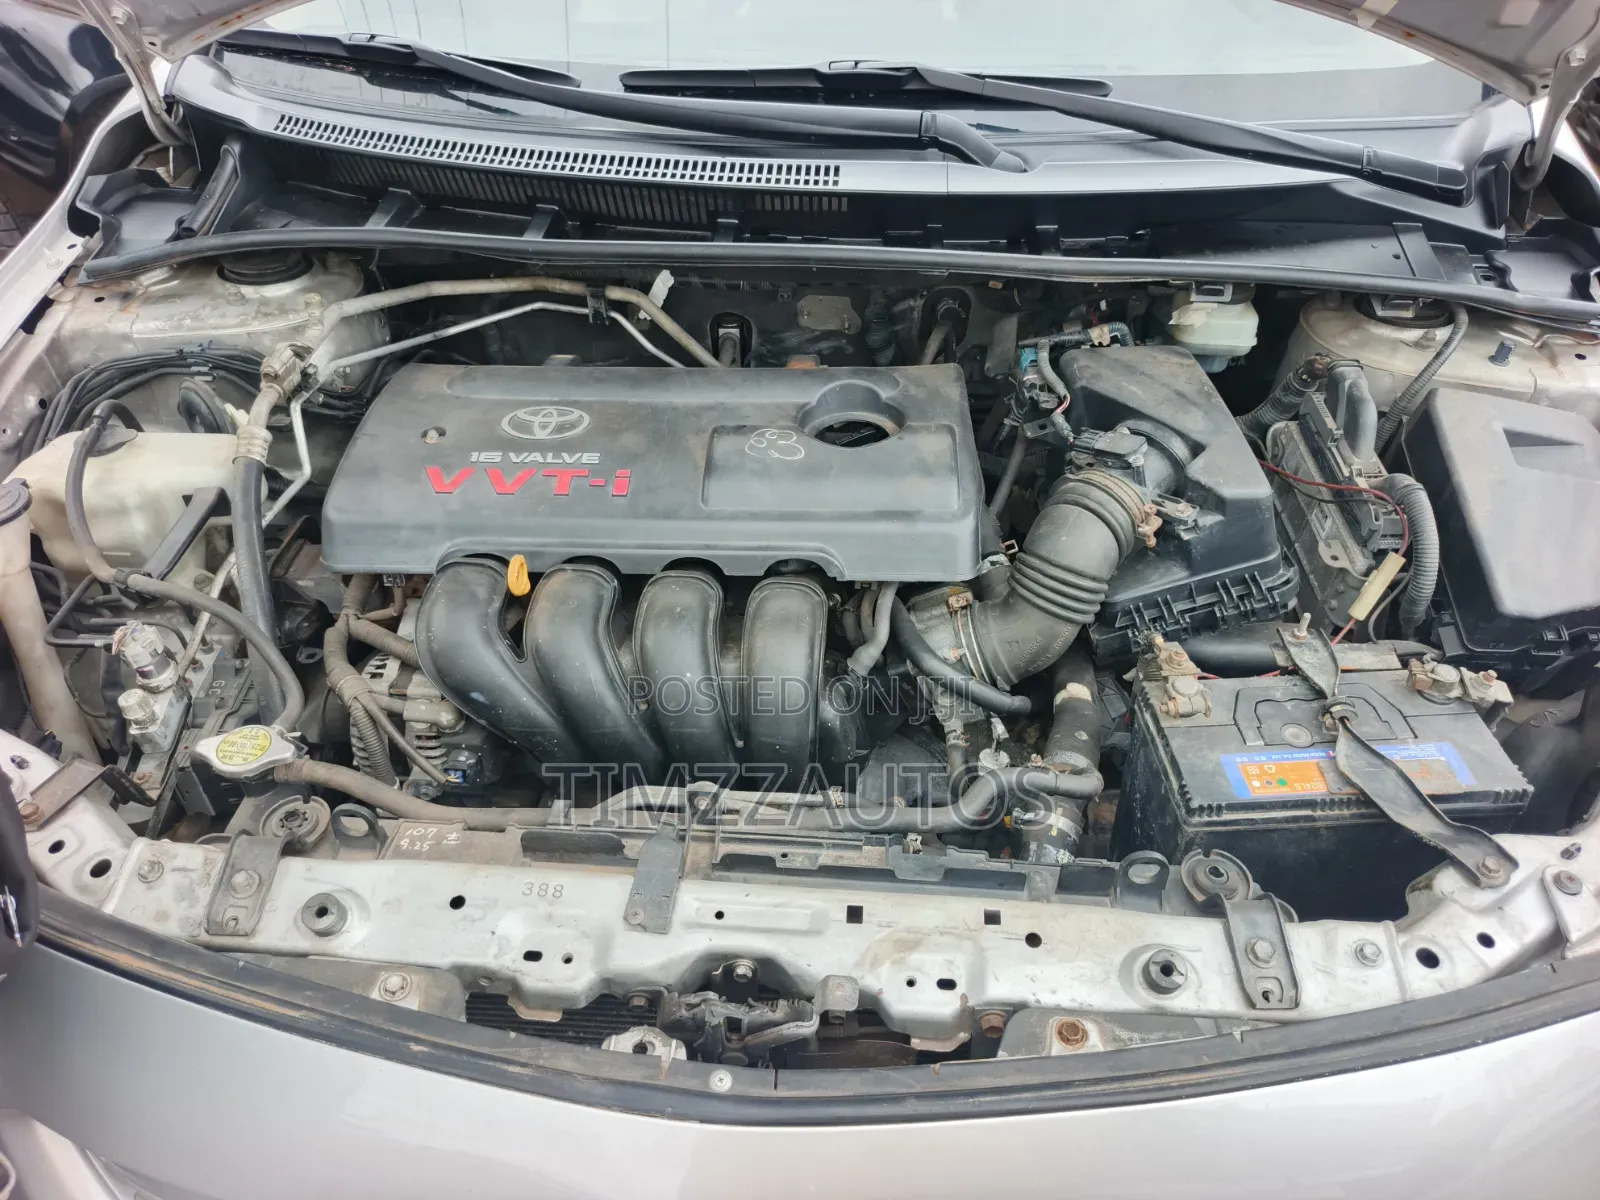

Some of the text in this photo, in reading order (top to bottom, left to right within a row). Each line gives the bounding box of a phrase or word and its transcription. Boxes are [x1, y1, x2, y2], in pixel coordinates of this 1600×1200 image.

[470, 451, 601, 464] 16 VALVE
[425, 466, 632, 496] VVT-i
[522, 881, 564, 899] 388
